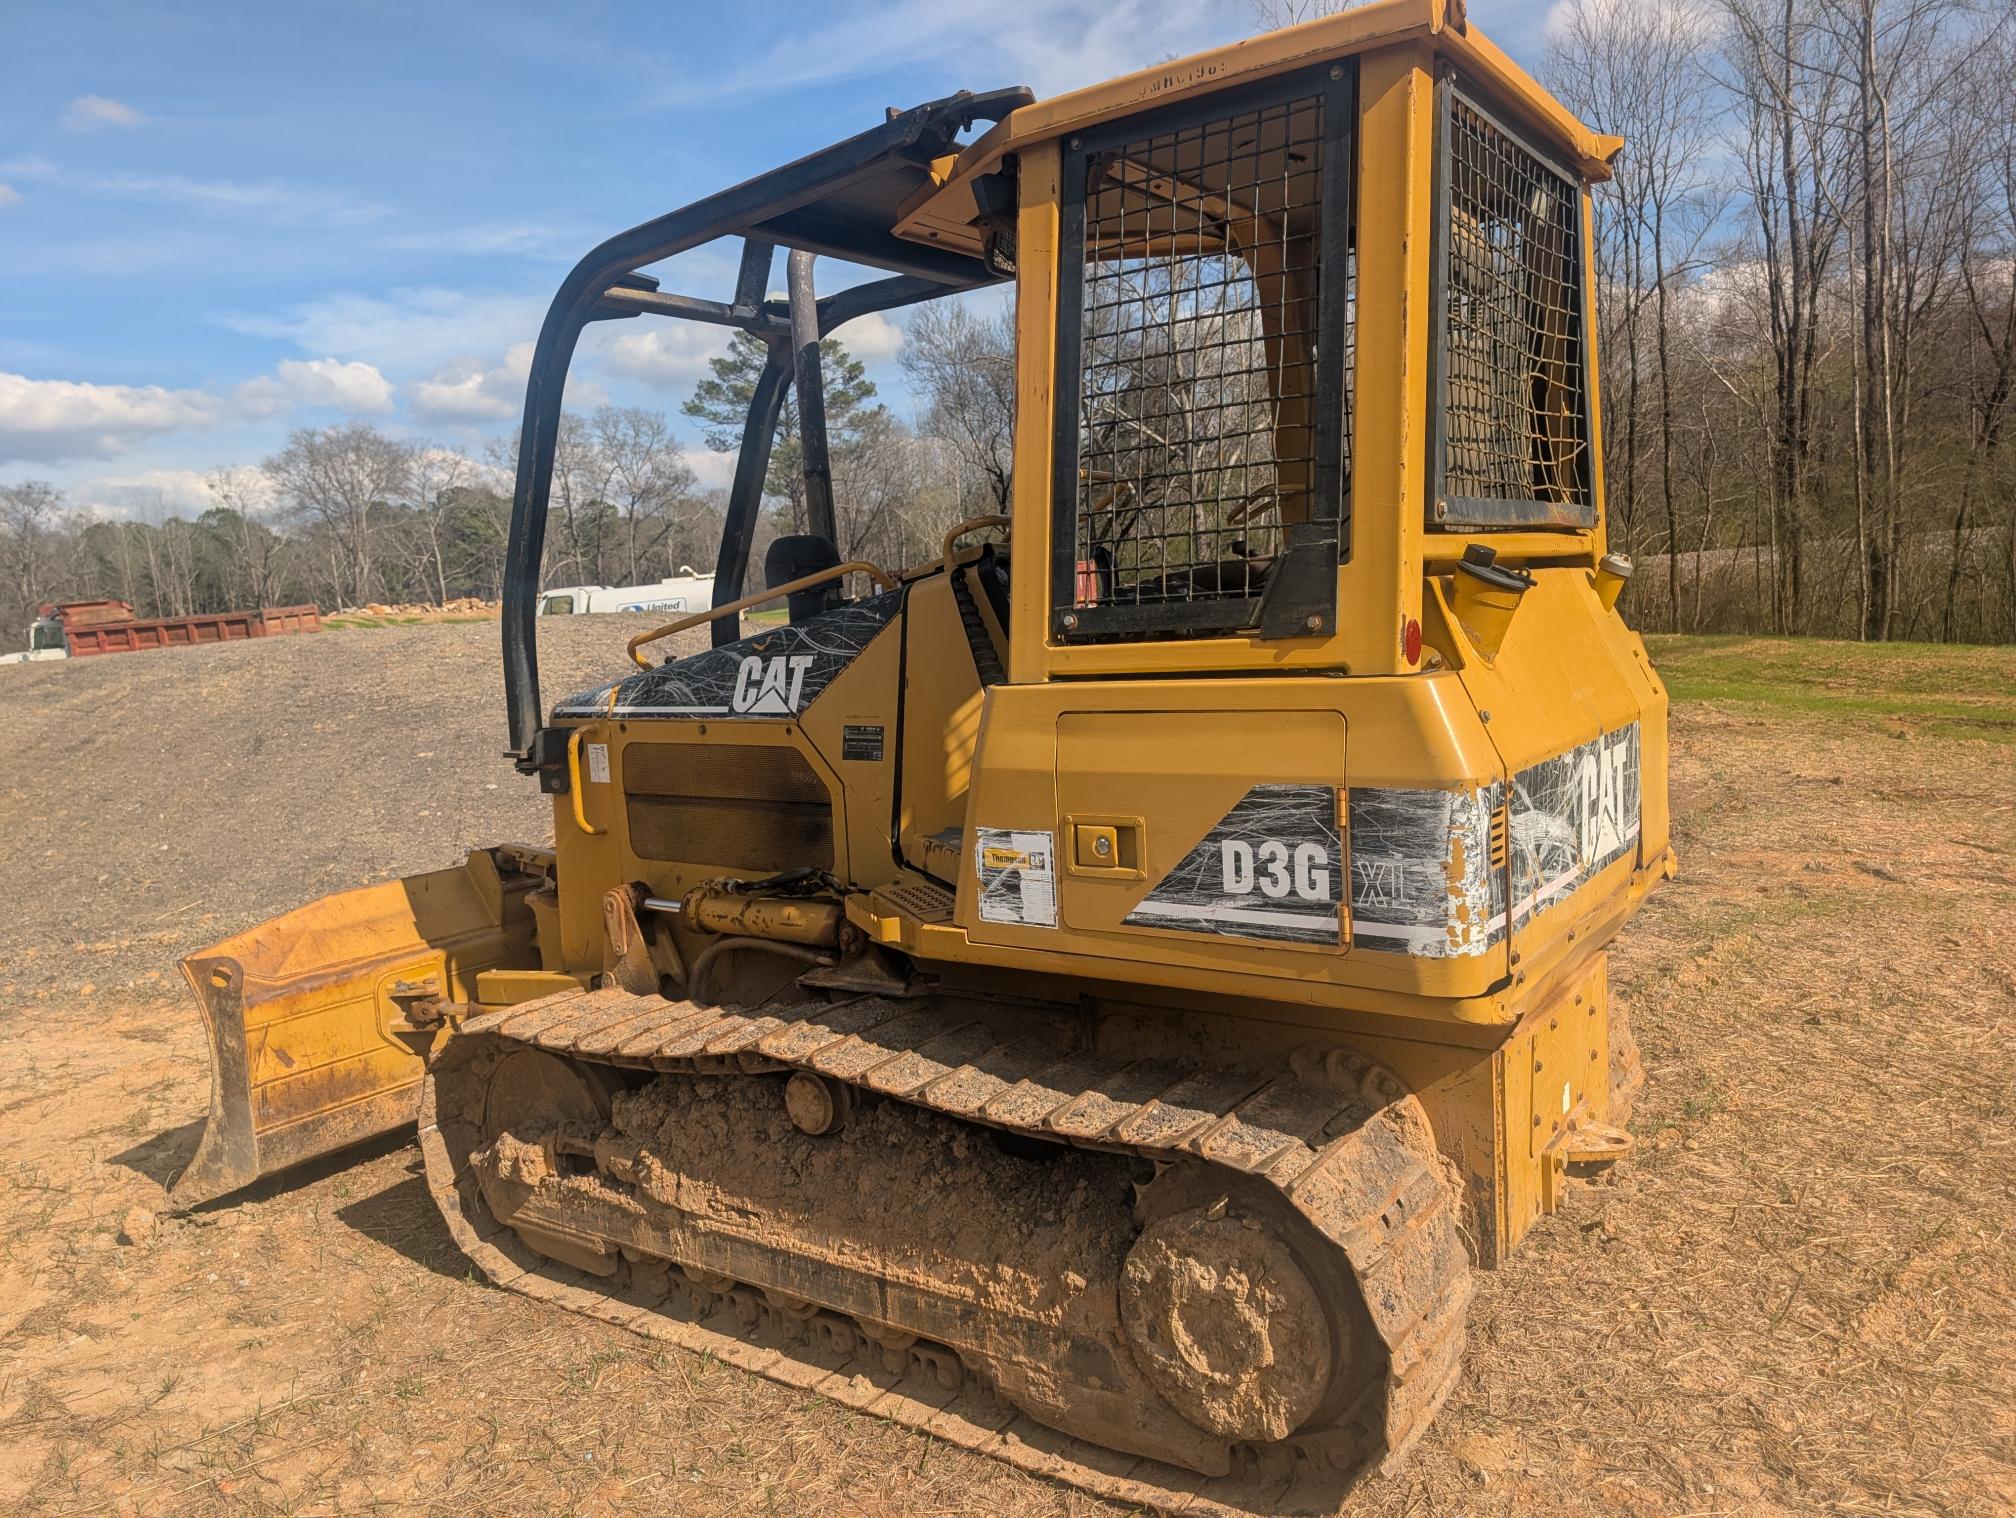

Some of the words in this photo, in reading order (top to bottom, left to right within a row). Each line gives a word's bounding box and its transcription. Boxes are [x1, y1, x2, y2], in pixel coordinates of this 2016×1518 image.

[647, 600, 680, 614] United
[732, 655, 814, 713] CAT
[1581, 740, 1627, 867] CAT
[992, 853, 1026, 864] Thompson
[1221, 839, 1331, 901] D3G
[1357, 860, 1417, 909] XL
